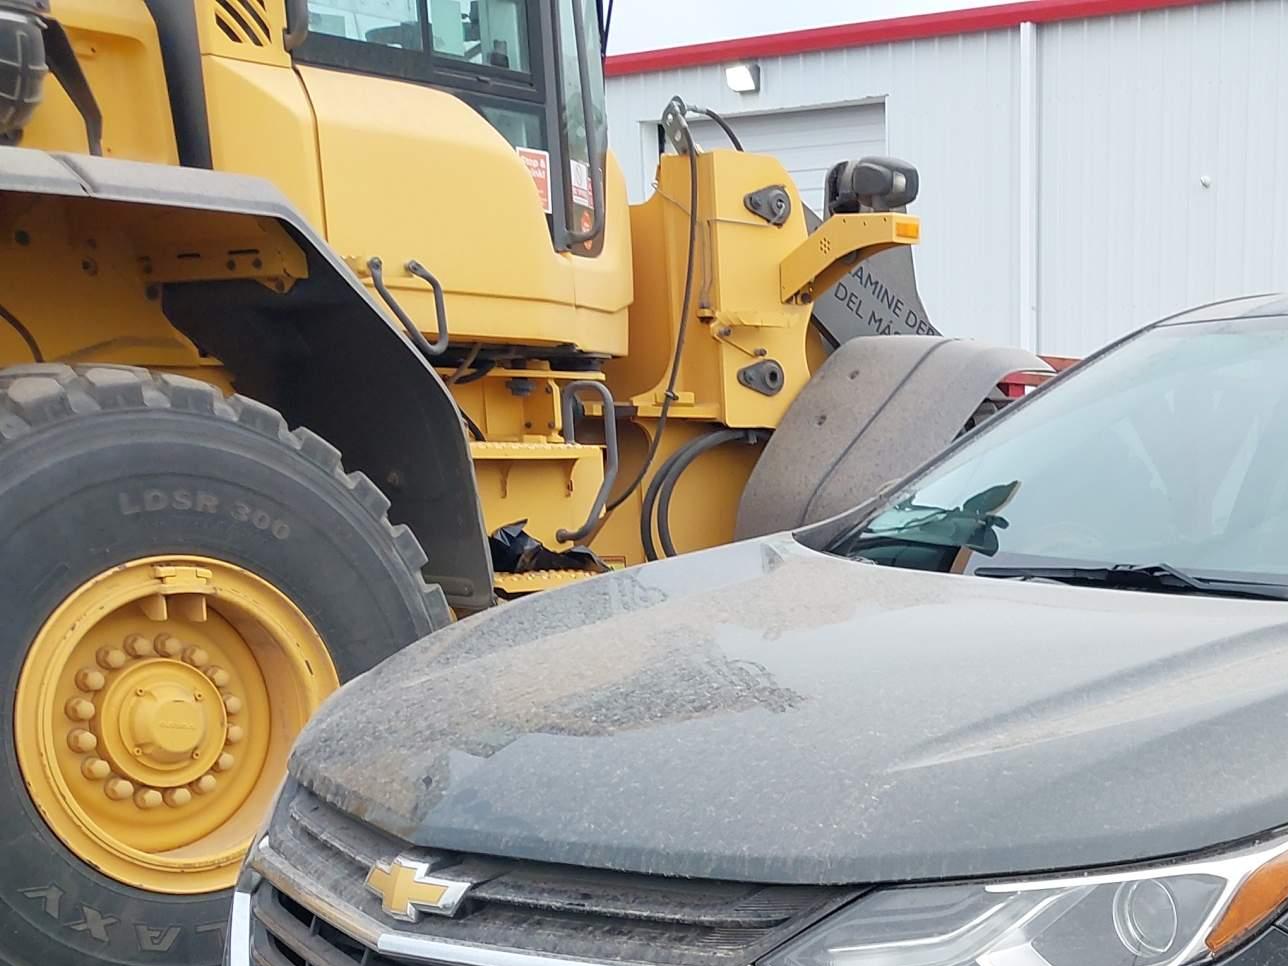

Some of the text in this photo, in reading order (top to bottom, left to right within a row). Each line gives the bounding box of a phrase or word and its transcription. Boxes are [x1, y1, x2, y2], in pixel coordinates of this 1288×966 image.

[834, 282, 901, 336] DEL MÁ
[848, 266, 904, 318] AMINE
[119, 488, 290, 540] LDSR 300
